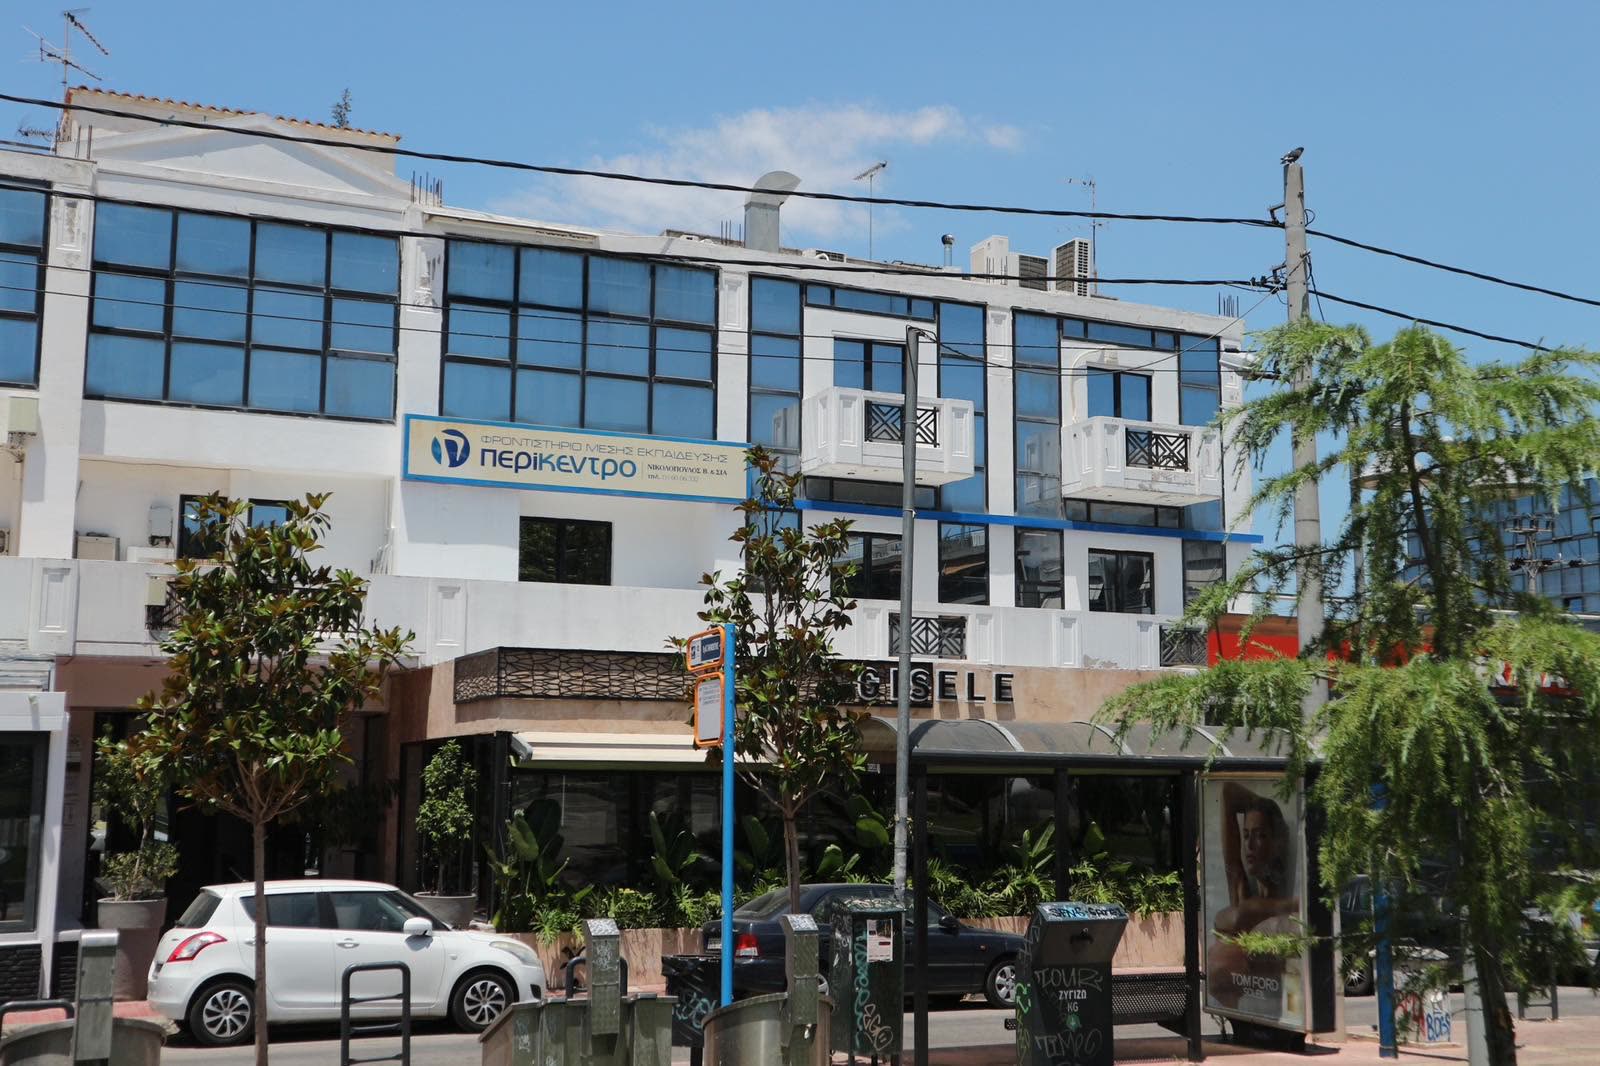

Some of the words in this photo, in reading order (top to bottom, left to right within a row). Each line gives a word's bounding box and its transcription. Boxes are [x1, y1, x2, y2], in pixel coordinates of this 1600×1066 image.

[481, 435, 582, 452] ΦΡΟΝΤΙΣΤΗΡΙΟ
[585, 443, 633, 456] ΜΕΣΗΣ
[637, 447, 728, 463] ΕΚΠΑΙΔΕΥΣΗΣ
[857, 667, 1014, 704] GISELE
[1231, 972, 1251, 987] TOM
[1252, 976, 1279, 992] FORD
[1058, 989, 1087, 1000] ΖΥΓΙΖΩ
